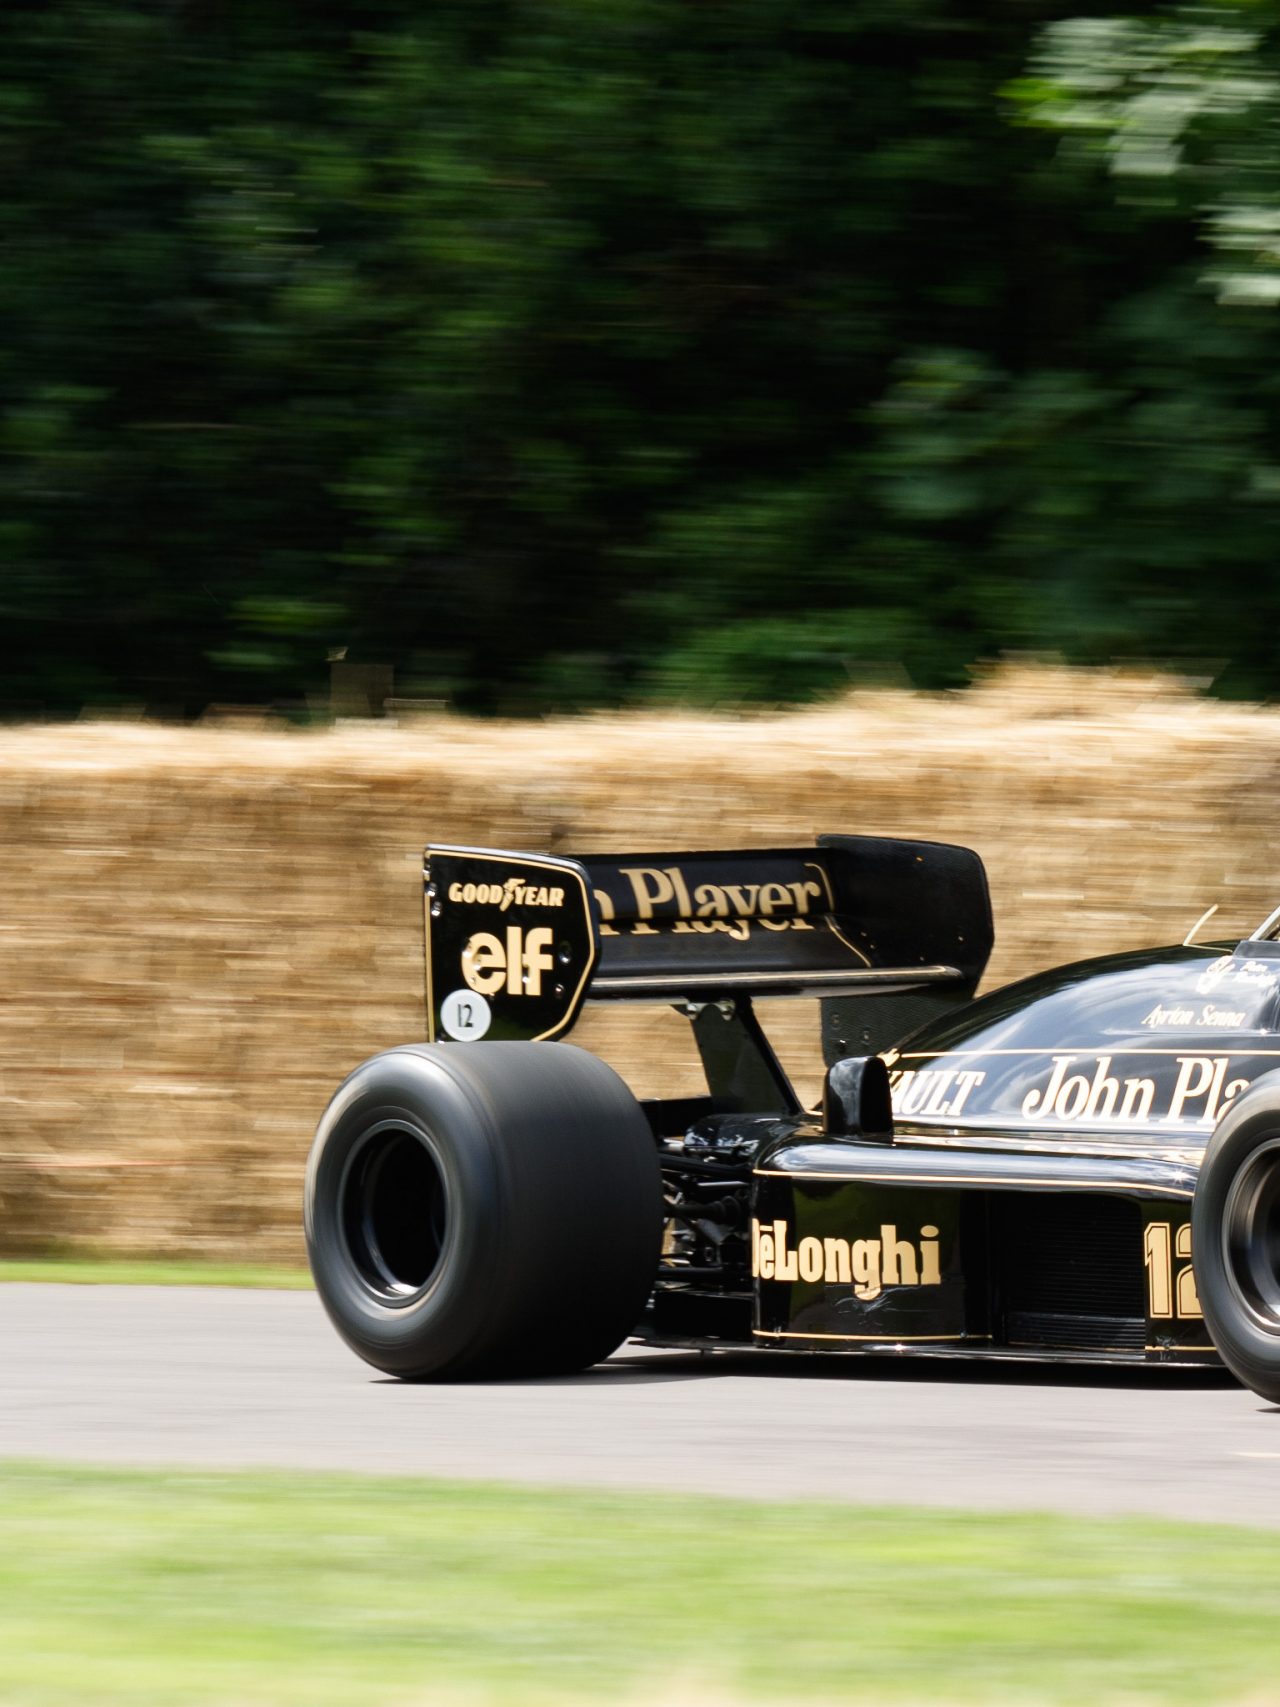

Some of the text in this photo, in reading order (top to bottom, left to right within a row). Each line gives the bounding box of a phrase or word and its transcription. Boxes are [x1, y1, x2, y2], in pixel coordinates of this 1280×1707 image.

[449, 878, 565, 911] GOODYEAR
[619, 867, 822, 941] Player
[461, 926, 554, 996] elf
[456, 1003, 475, 1028] 12
[1142, 1004, 1246, 1028] Ayrton Senna
[889, 1070, 986, 1116] AULT
[1022, 1055, 1156, 1122] John
[1158, 1056, 1253, 1127] Pla
